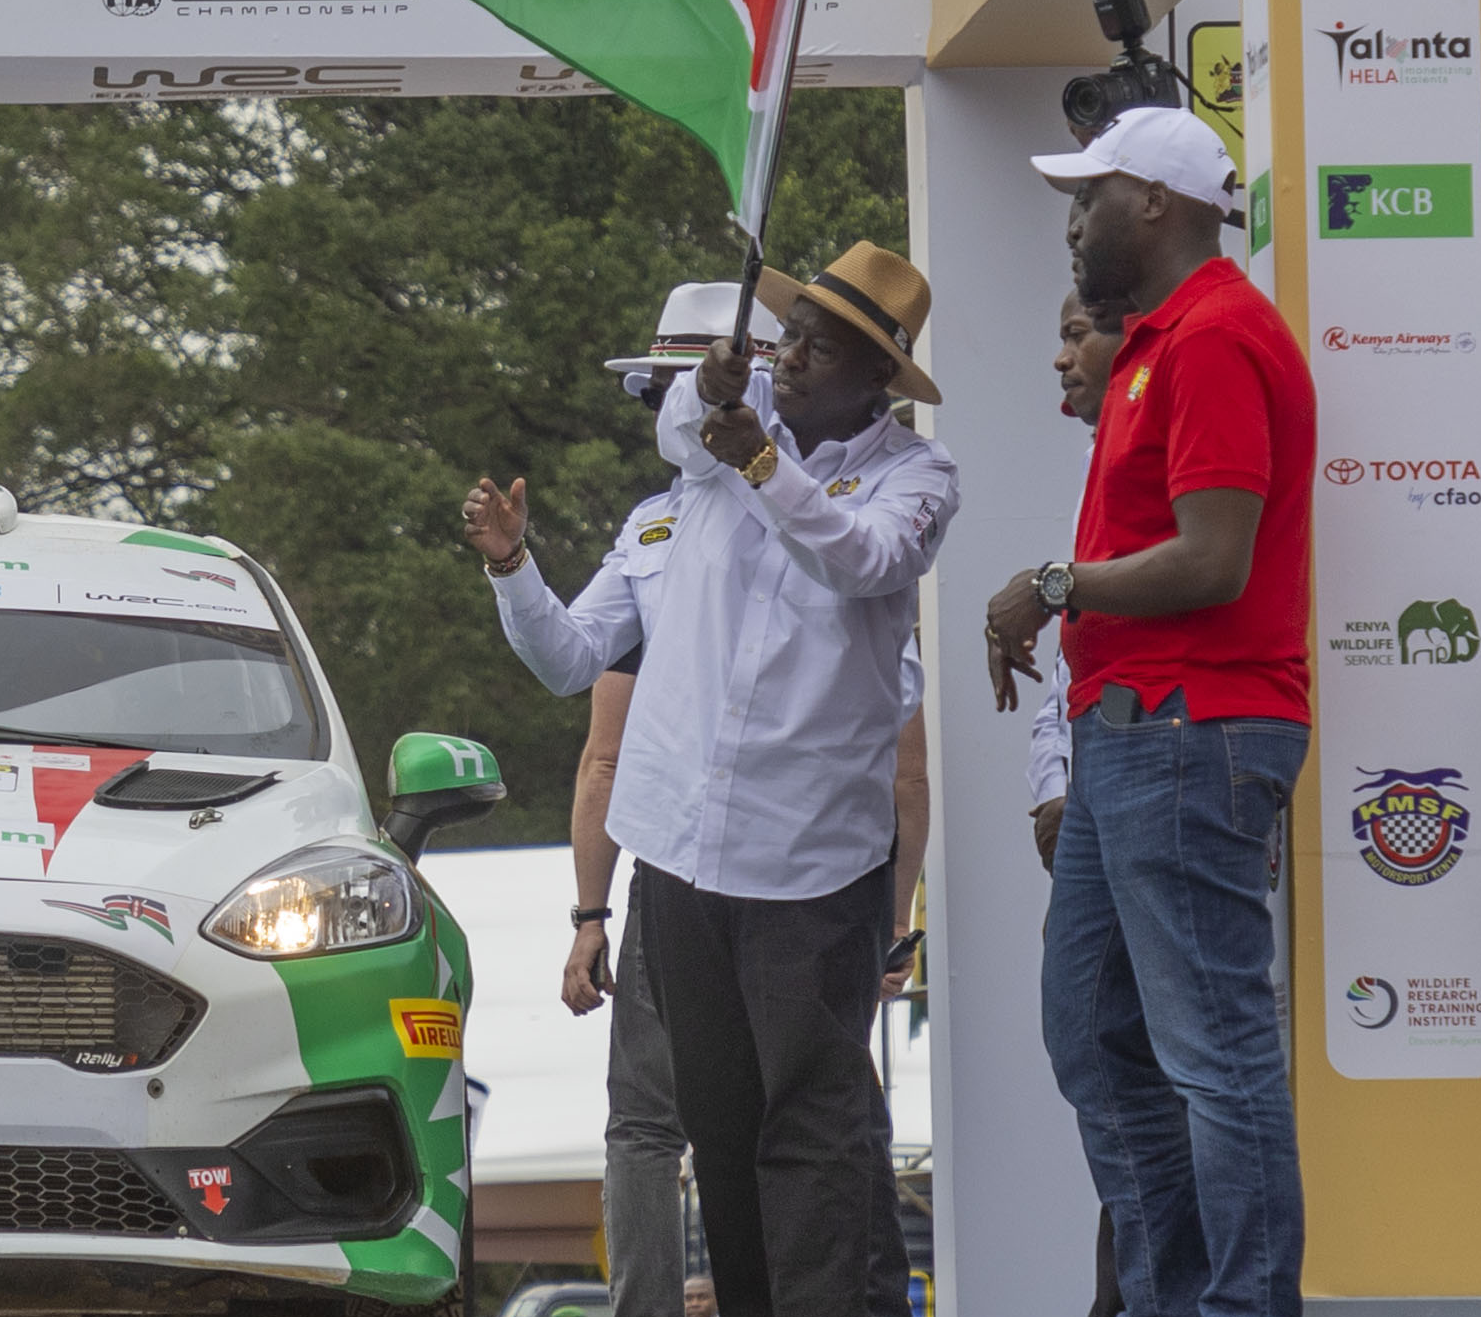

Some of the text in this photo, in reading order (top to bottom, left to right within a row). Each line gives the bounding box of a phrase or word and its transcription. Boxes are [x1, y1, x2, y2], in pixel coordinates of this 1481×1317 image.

[177, 4, 410, 18] CHAMPIONSHIP
[1349, 69, 1399, 83] HELA
[1371, 187, 1434, 216] KCB
[1352, 333, 1451, 346] Kenya Airways
[1369, 460, 1481, 481] TOYOTA
[1433, 487, 1481, 505] cfao
[1346, 622, 1391, 632] KENYA
[1329, 639, 1394, 650] WILDLIFE
[1345, 655, 1394, 666] SERVICE
[1358, 795, 1464, 821] KMSF
[1365, 851, 1460, 884] MOTORSPORT KENYA
[1407, 978, 1471, 988] WILDLIFE
[1407, 990, 1478, 1001] RESEARCH
[1407, 1003, 1416, 1013] &
[1408, 1016, 1477, 1026] INSTITUTE
[188, 1168, 230, 1187] TOW
